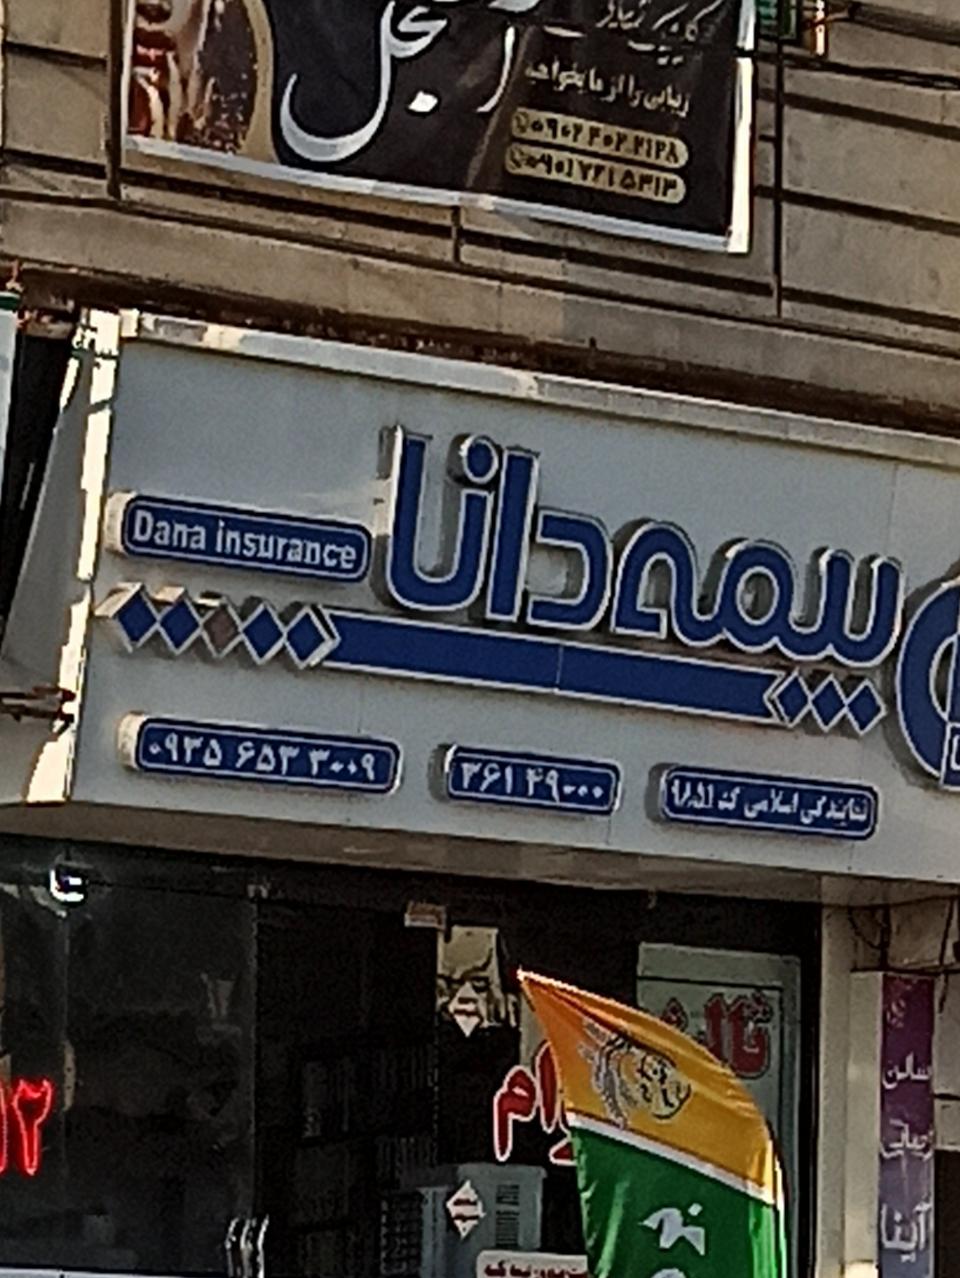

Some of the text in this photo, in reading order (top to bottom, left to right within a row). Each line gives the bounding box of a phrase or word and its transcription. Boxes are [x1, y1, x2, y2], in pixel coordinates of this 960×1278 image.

[131, 508, 358, 572] Dana insurance
[384, 425, 613, 633] دانا
[149, 731, 377, 783] ۰۹۳۵ ۶۵۳ ۳۰۰۹
[459, 761, 605, 804] ۳۶۱ ۴۹۰۰۰
[882, 1052, 933, 1090] سالن
[880, 1198, 932, 1263] آینا
